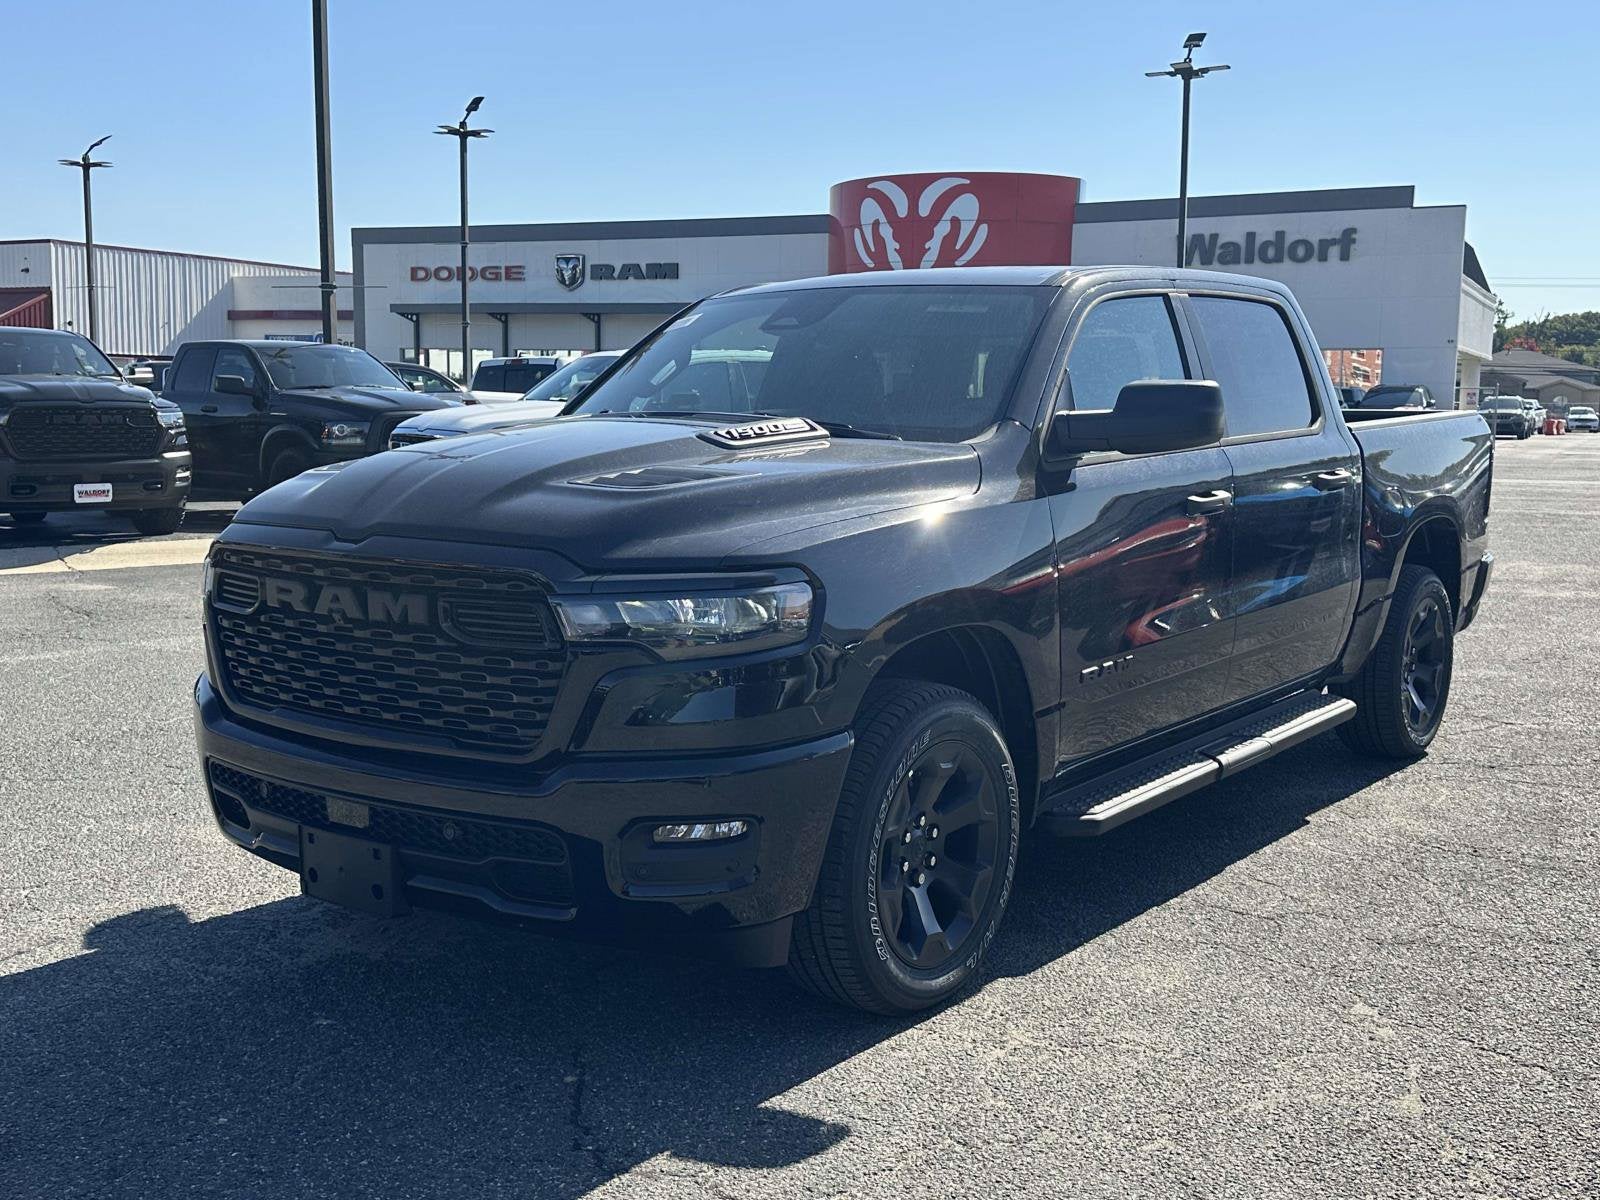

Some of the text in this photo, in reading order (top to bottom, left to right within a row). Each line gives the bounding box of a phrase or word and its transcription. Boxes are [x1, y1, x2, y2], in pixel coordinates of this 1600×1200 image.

[1177, 227, 1358, 266] Waldorf
[410, 265, 526, 282] DODGE
[590, 262, 679, 281] RAM
[728, 421, 786, 440] 1500
[264, 576, 431, 627] RAM
[867, 729, 932, 961] BRIDGESTONE
